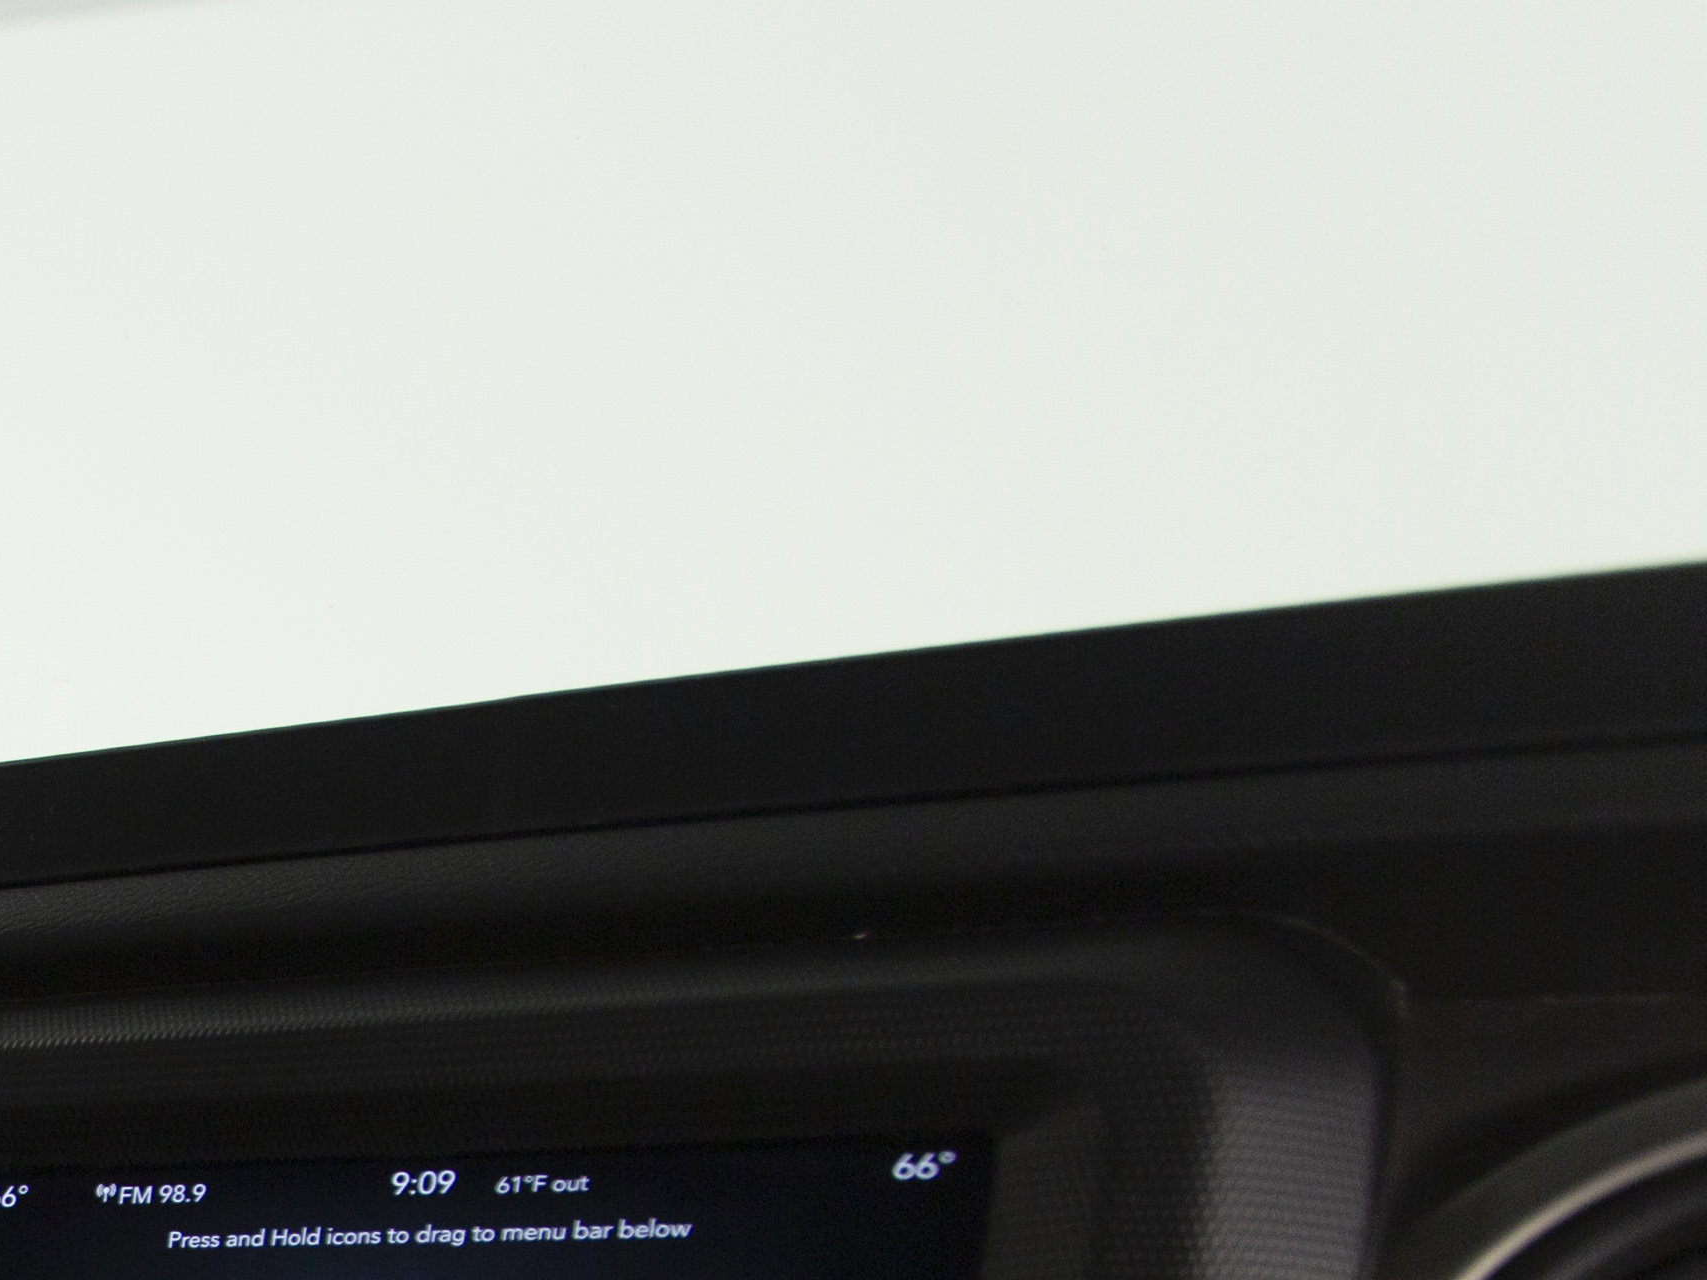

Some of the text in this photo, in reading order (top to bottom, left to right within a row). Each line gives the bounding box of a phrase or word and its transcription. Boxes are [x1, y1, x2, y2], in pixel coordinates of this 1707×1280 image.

[891, 1151, 957, 1180] 66°
[118, 1184, 208, 1204] FM 98.9
[391, 1170, 457, 1195] 9:09
[494, 1174, 590, 1194] 61°F out
[168, 1218, 692, 1249] Press and Hold icons to drag to menu bar below
